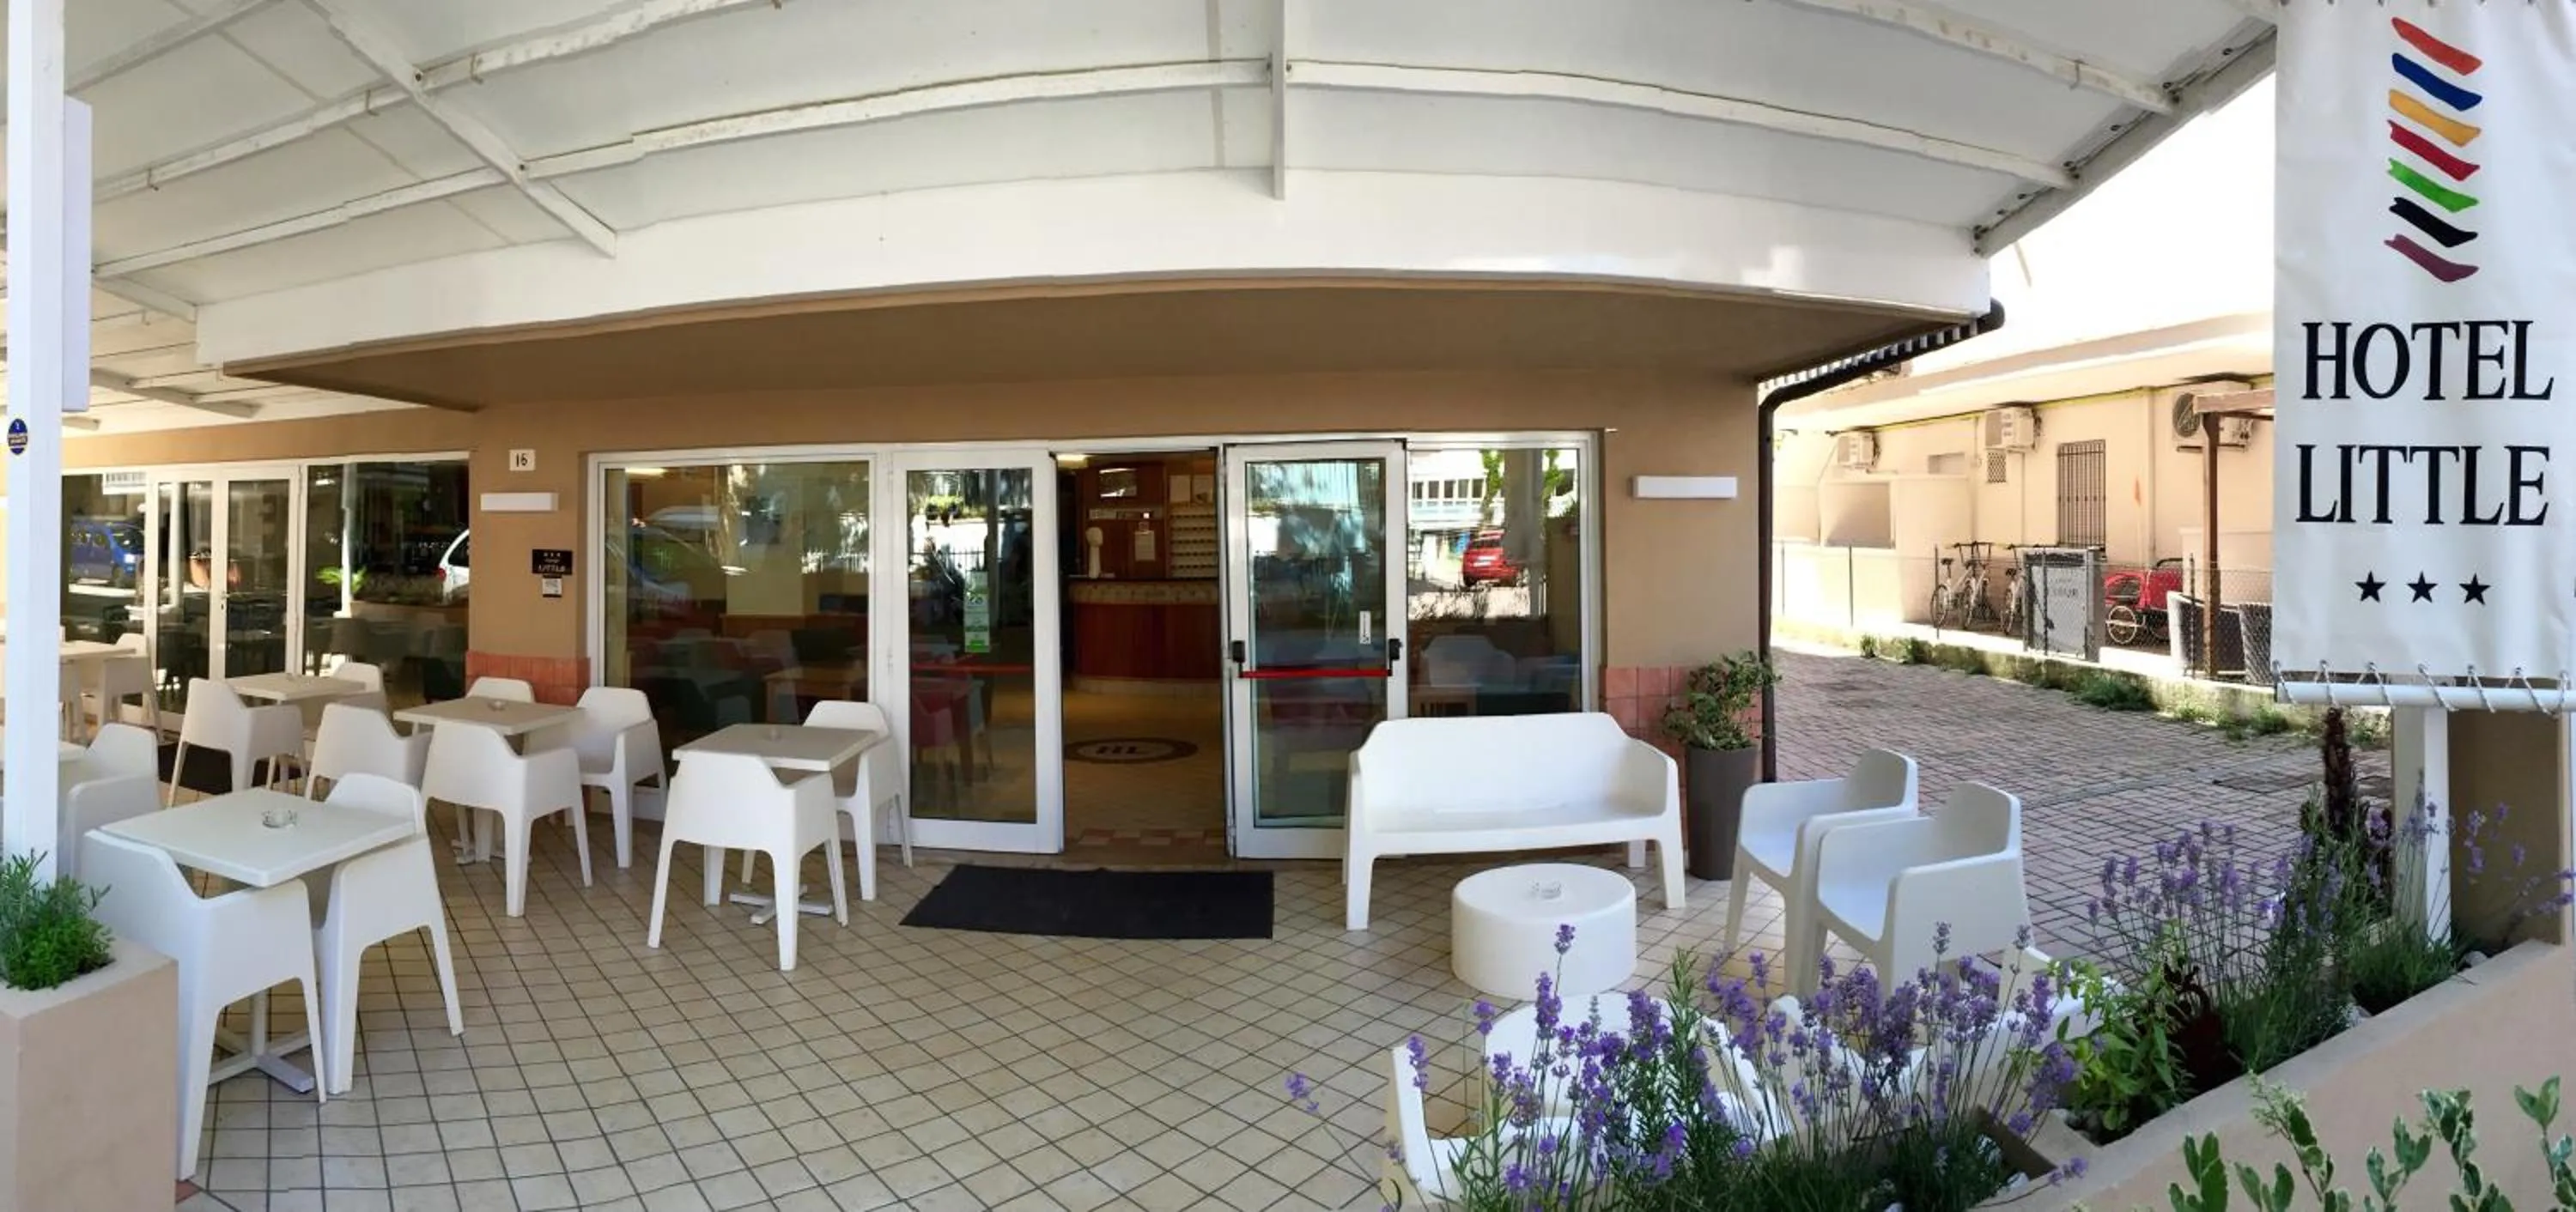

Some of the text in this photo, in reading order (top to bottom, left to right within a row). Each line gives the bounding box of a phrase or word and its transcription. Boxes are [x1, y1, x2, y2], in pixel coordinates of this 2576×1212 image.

[2301, 320, 2554, 400] HOTEL
[515, 452, 529, 467] 16
[2295, 445, 2549, 525] LITTLE
